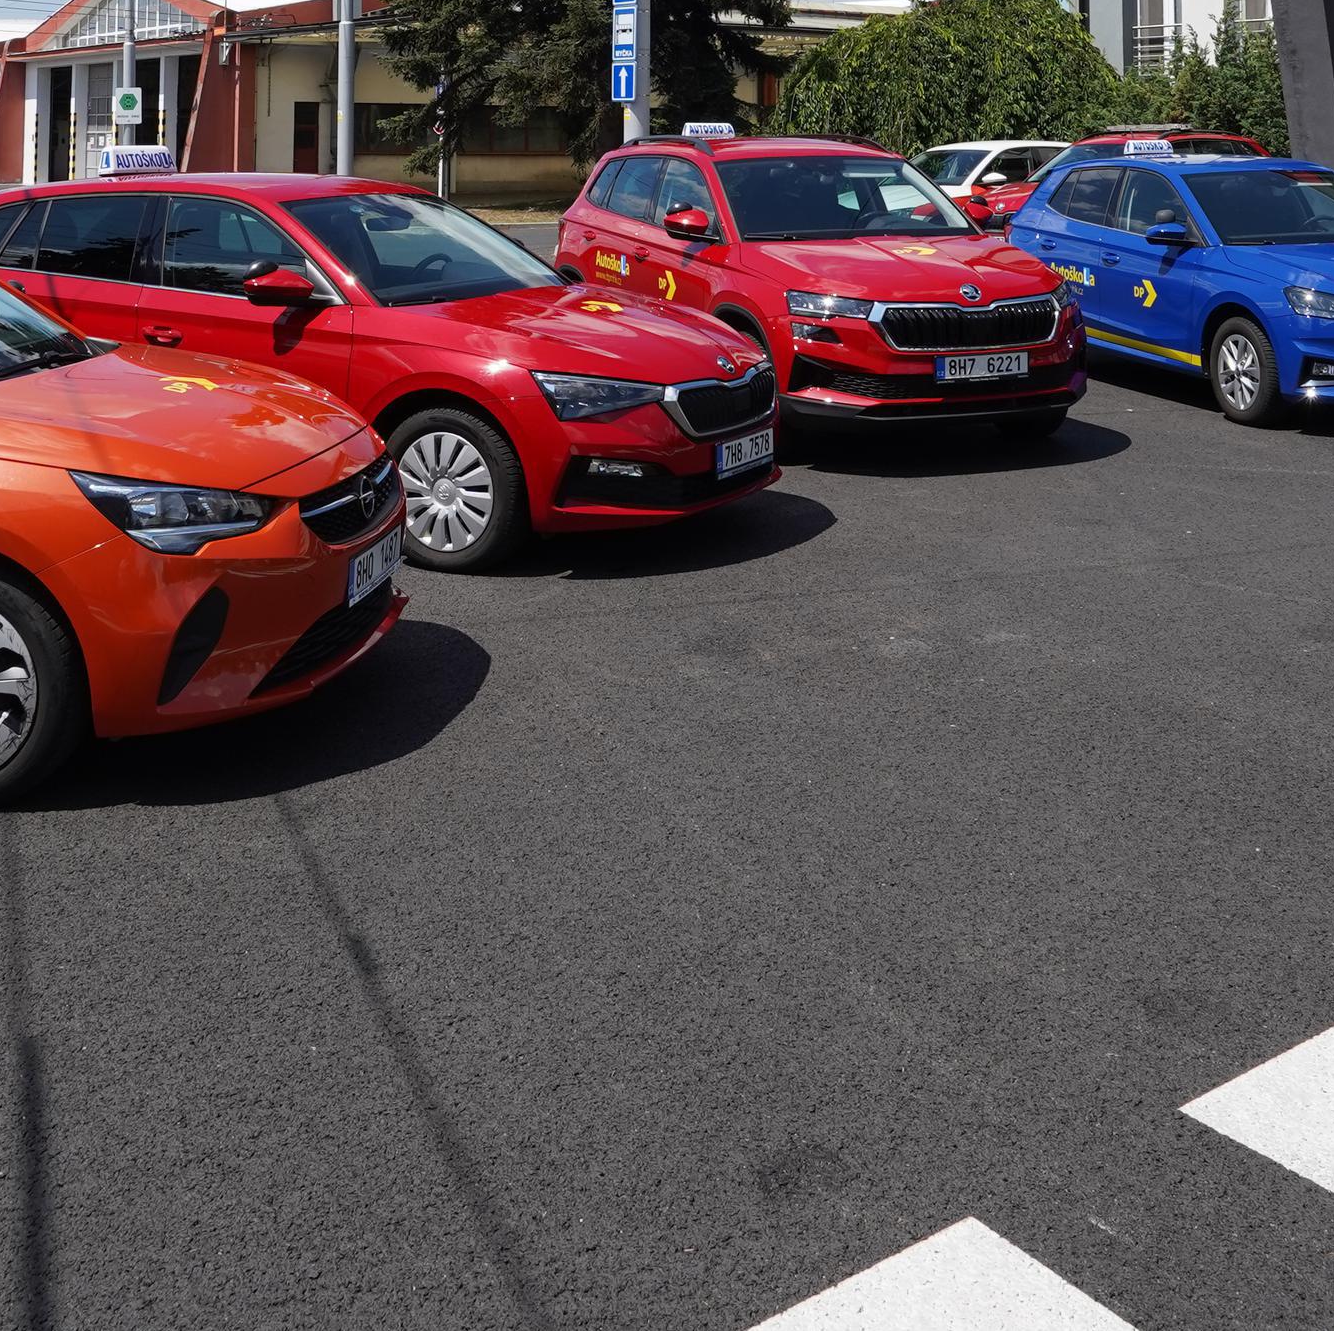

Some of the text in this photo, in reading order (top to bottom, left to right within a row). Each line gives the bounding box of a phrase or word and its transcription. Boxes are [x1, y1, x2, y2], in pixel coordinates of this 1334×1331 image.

[658, 277, 667, 290] DP
[1133, 286, 1145, 298] DP
[948, 358, 976, 376] 8H7
[987, 355, 1021, 374] 6221
[725, 442, 743, 467] 7H8
[749, 432, 770, 459] 7578
[381, 531, 398, 571] 1487
